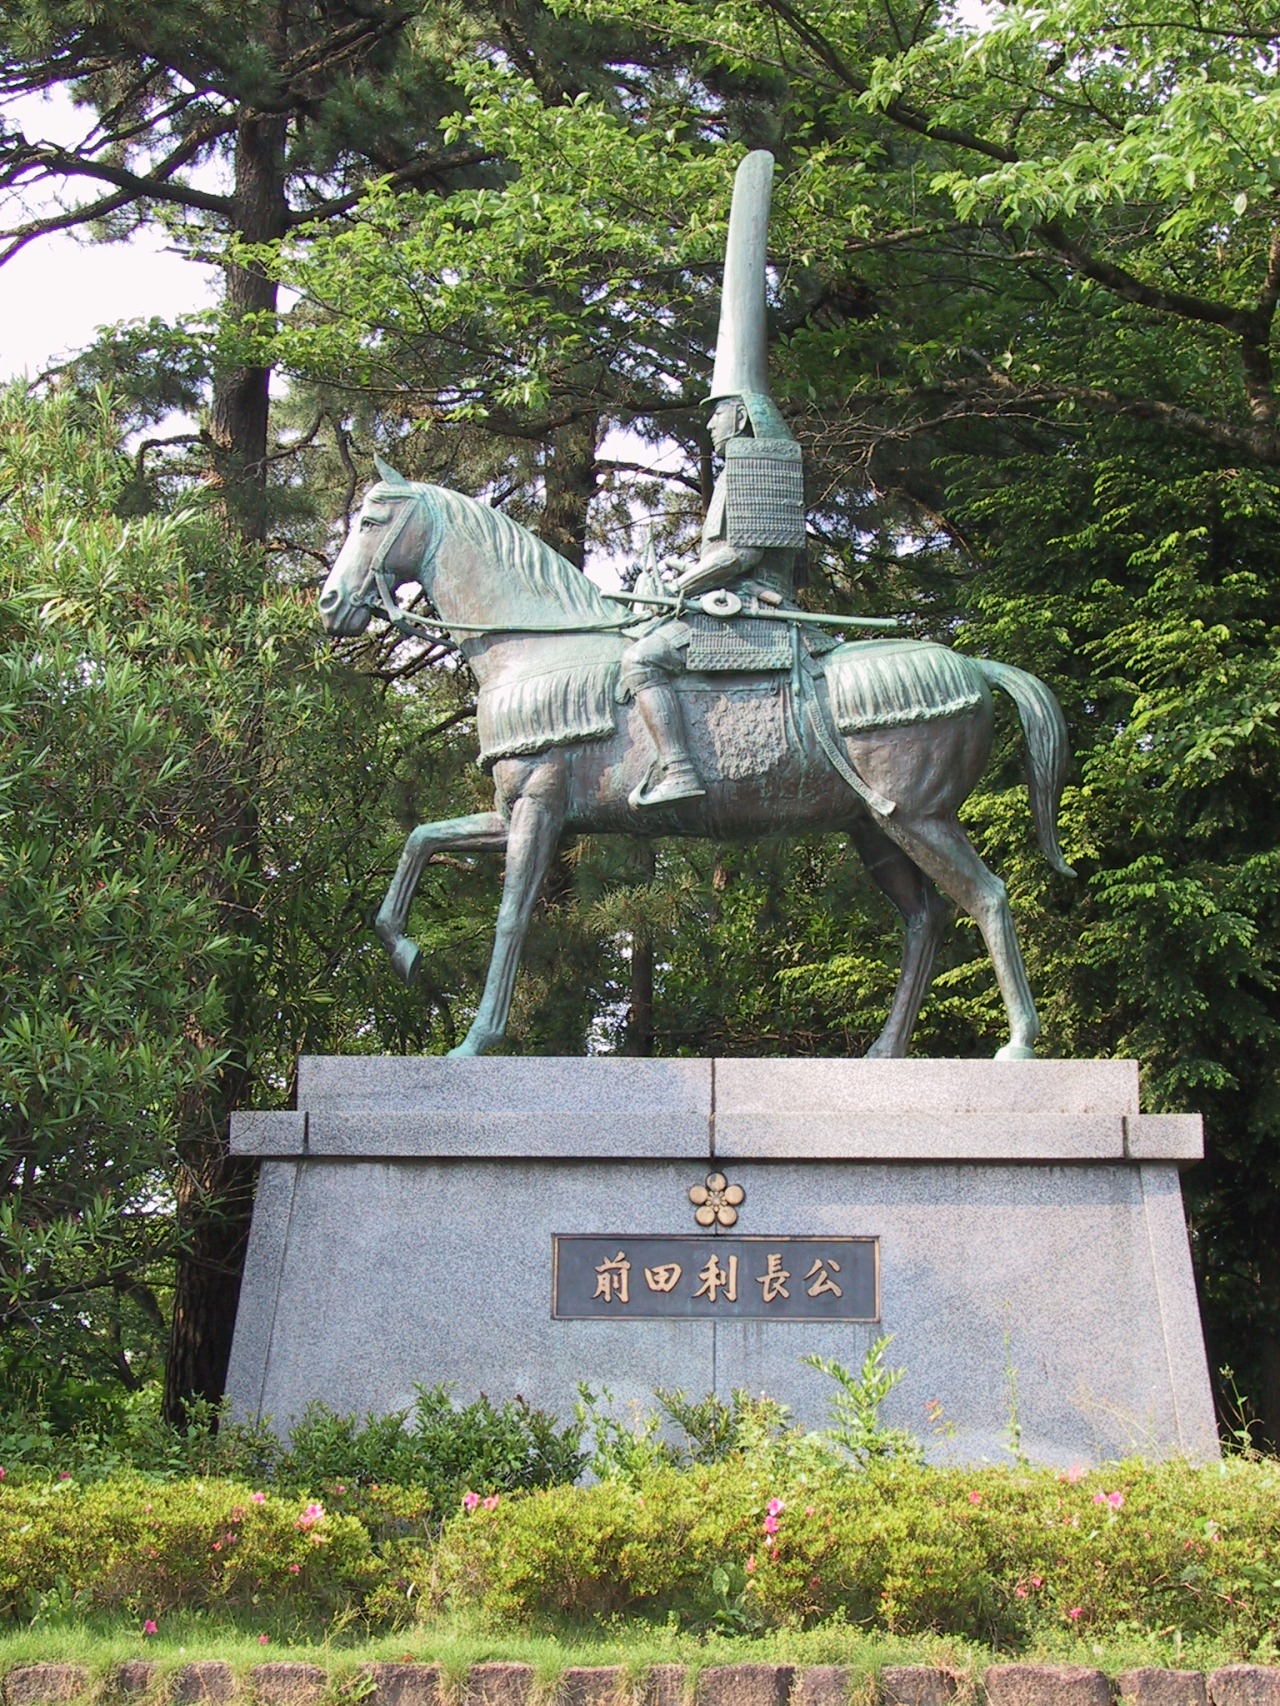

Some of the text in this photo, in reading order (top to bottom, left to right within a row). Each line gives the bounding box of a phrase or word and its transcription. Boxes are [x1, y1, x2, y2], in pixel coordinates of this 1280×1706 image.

[591, 1251, 844, 1304] 前田利長公
